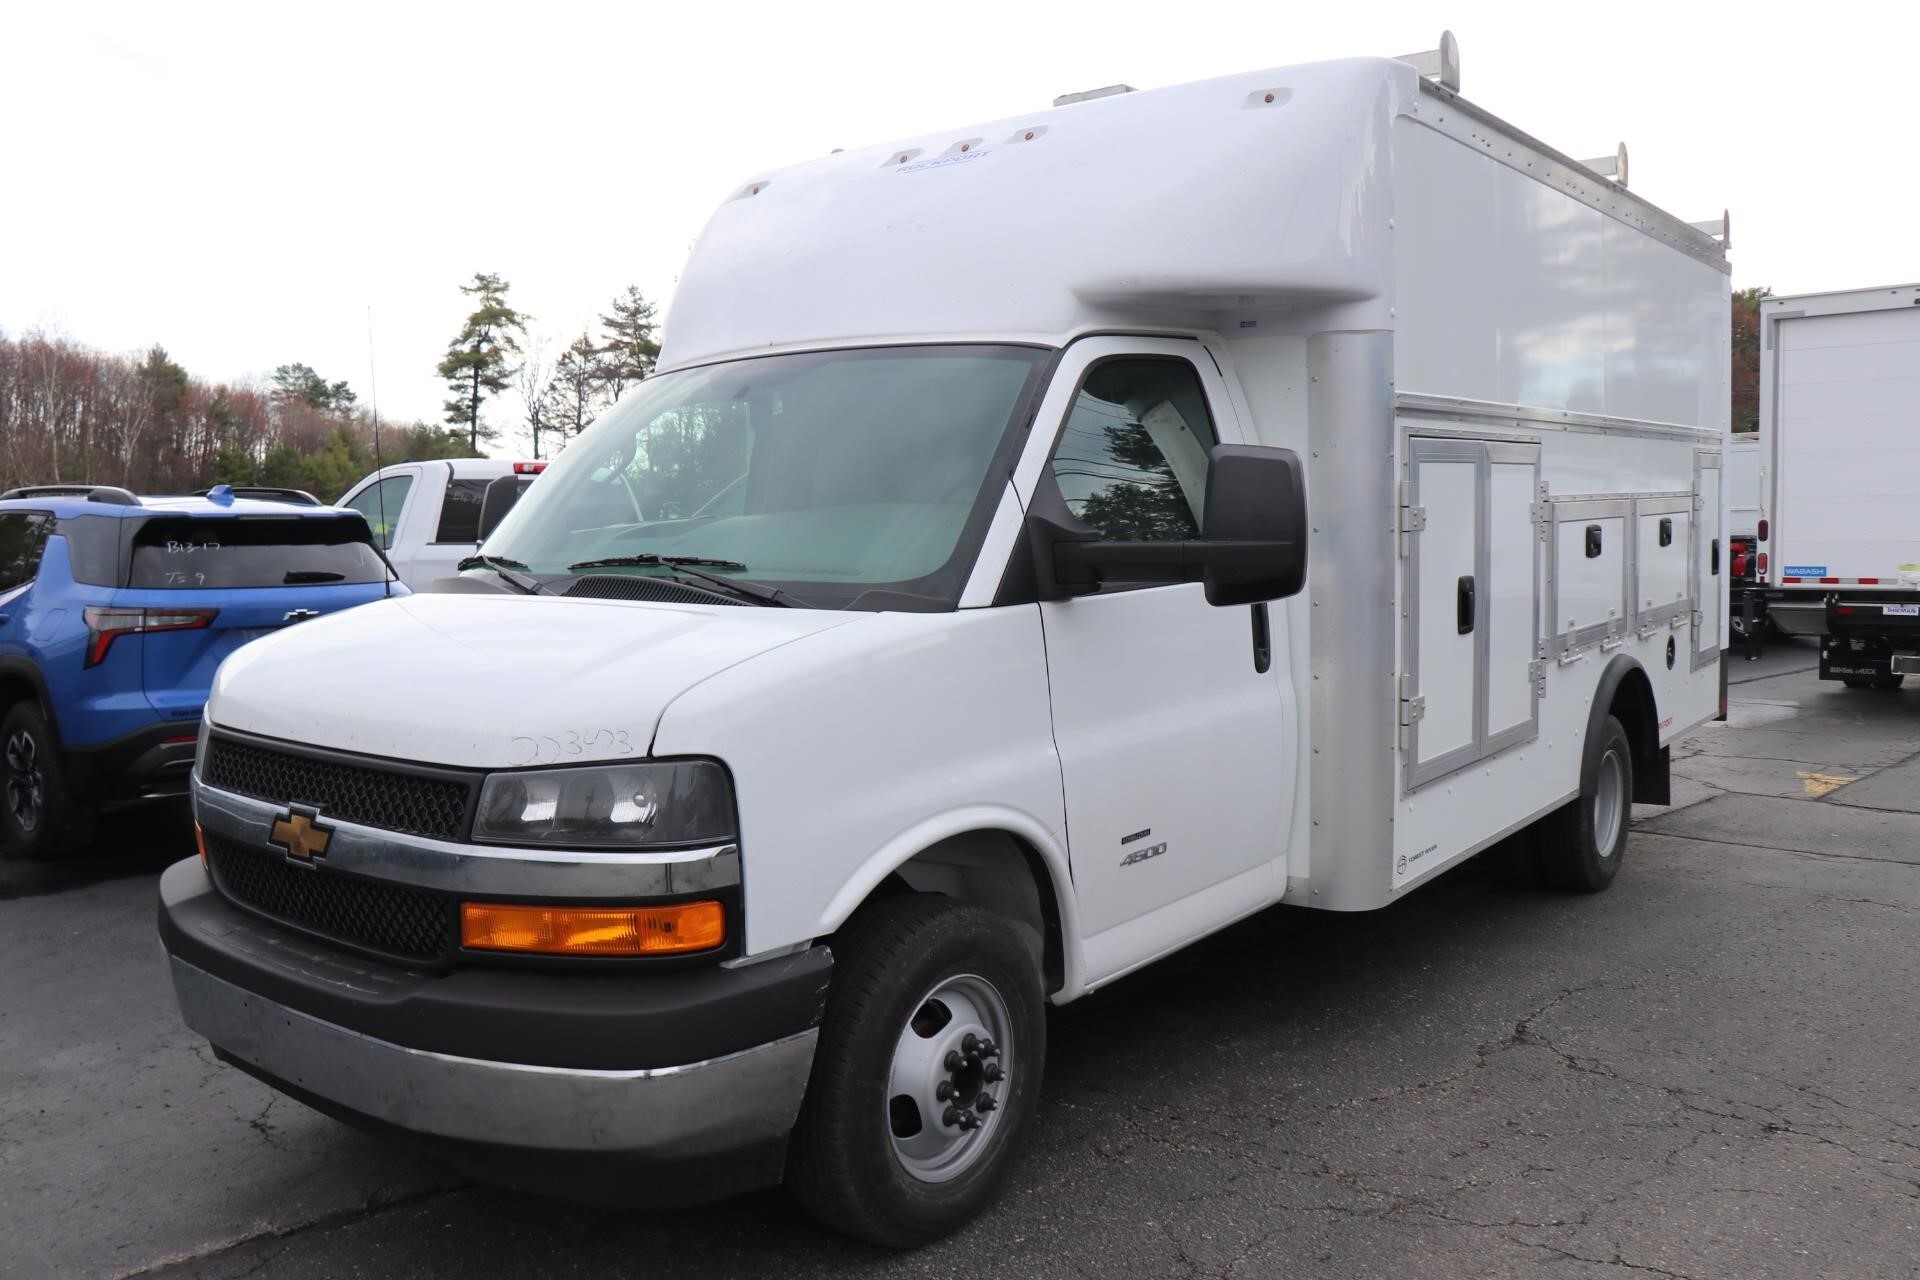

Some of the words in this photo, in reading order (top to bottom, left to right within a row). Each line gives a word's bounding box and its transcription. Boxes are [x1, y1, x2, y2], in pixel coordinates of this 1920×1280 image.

[895, 150, 993, 173] ROCKPORT
[1785, 568, 1825, 576] WABASH
[1119, 842, 1168, 867] 4500
[1409, 850, 1424, 862] FOREST
[1425, 844, 1438, 854] RIVER
